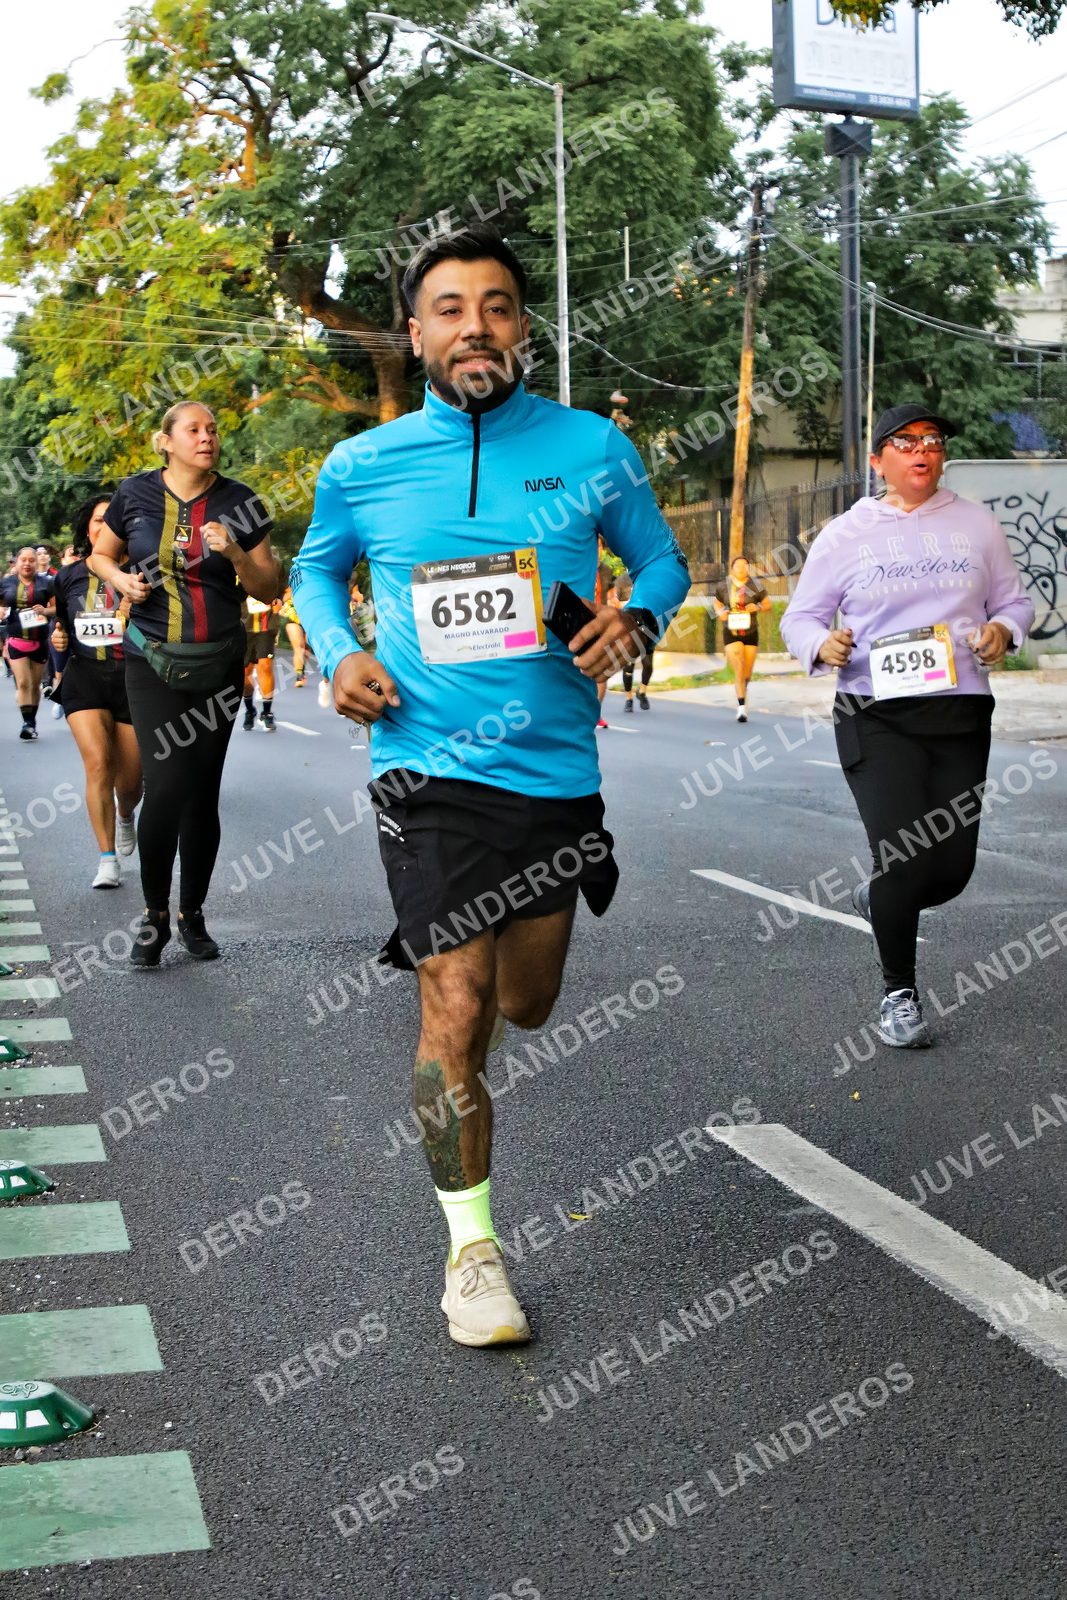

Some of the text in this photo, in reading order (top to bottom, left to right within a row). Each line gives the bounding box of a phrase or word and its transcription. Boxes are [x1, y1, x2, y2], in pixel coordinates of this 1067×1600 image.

[524, 476, 566, 492] NASA
[983, 491, 1049, 517] TOY
[519, 557, 534, 570] 5K
[858, 531, 971, 570] AERO
[861, 556, 971, 590] New York
[431, 587, 517, 629] 6582
[82, 623, 115, 636] 2513
[444, 626, 510, 640] MAGNO ALVARADO
[881, 648, 936, 675] 4598
